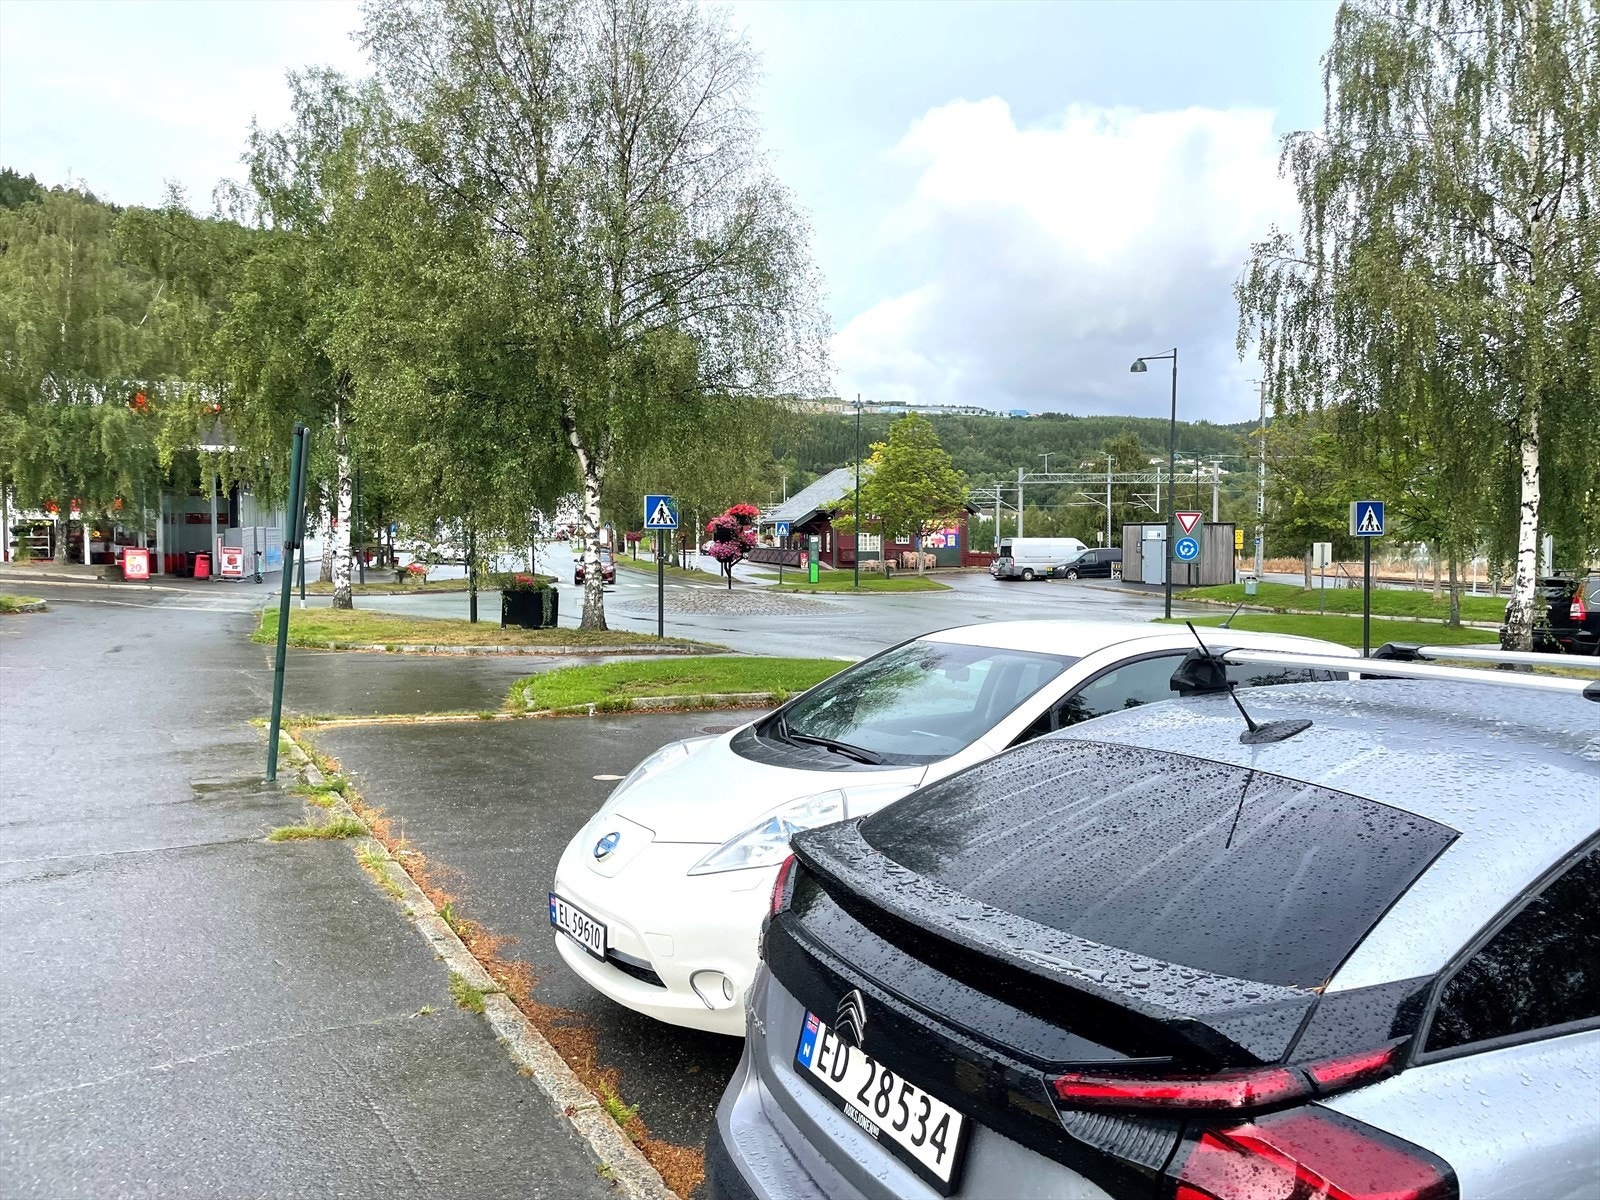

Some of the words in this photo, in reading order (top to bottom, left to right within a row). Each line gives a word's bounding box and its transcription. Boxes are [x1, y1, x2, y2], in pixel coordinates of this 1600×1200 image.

[559, 903, 570, 928] EL
[572, 912, 601, 949] 59610
[803, 1043, 811, 1058] N
[817, 1026, 850, 1083] ED
[857, 1057, 951, 1165] 28534
